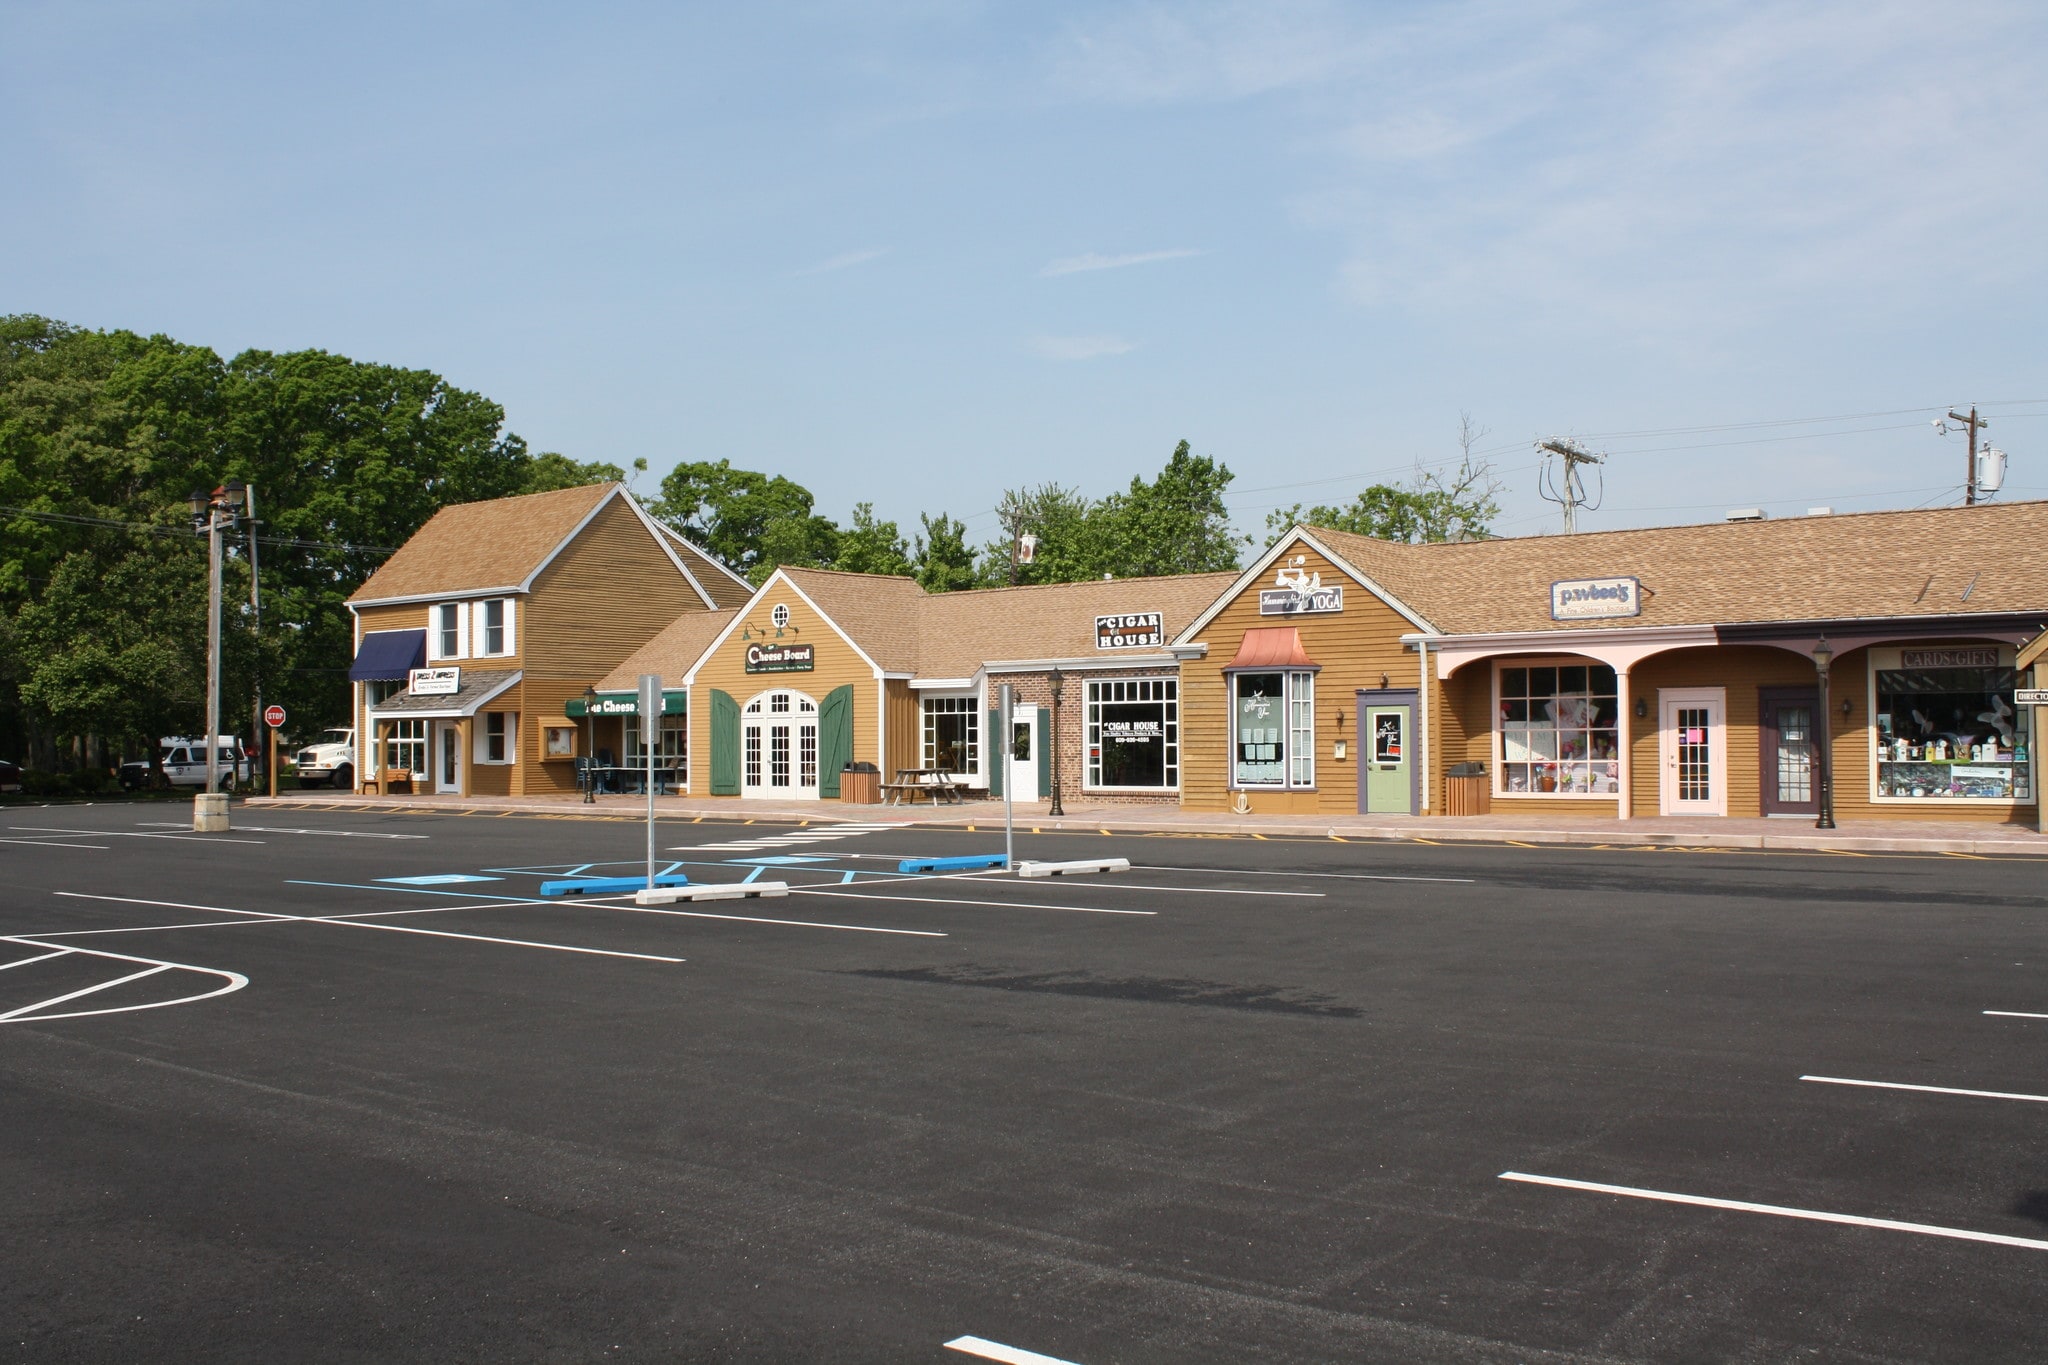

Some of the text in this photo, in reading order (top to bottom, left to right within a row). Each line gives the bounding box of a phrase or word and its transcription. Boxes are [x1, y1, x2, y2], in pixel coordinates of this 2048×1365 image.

[1312, 595, 1340, 609] YOGA
[1107, 614, 1158, 628] CIGAR
[1100, 633, 1159, 647] HOUSE
[748, 646, 810, 665] Cheese Board
[1904, 651, 1950, 666] CARDS
[1956, 650, 1997, 665] GIFTS
[603, 700, 635, 712] Cheese
[267, 712, 284, 720] STOP
[1108, 721, 1130, 731] CIGAR
[1133, 721, 1159, 730] HOUSE
